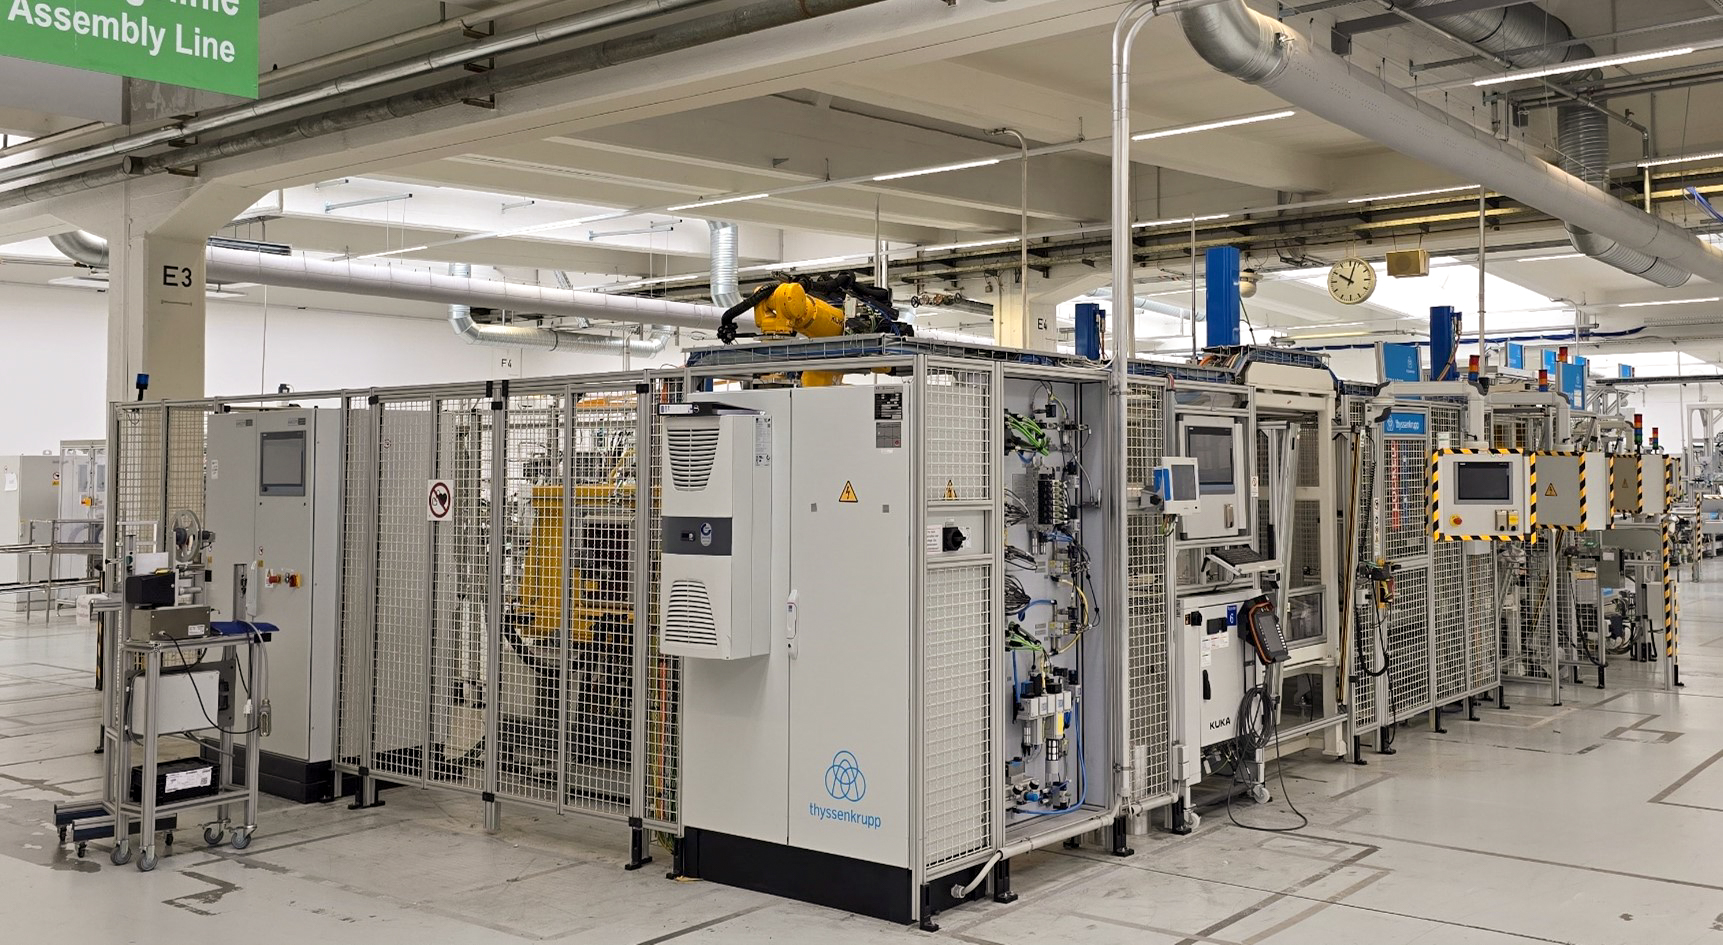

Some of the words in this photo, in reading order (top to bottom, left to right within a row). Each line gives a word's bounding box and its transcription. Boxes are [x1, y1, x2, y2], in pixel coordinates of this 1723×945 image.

[7, 0, 166, 56] Assembly
[175, 23, 236, 63] Line
[163, 265, 192, 288] E3
[1209, 716, 1231, 730] KUKA
[809, 802, 882, 830] thyssenkrupp
